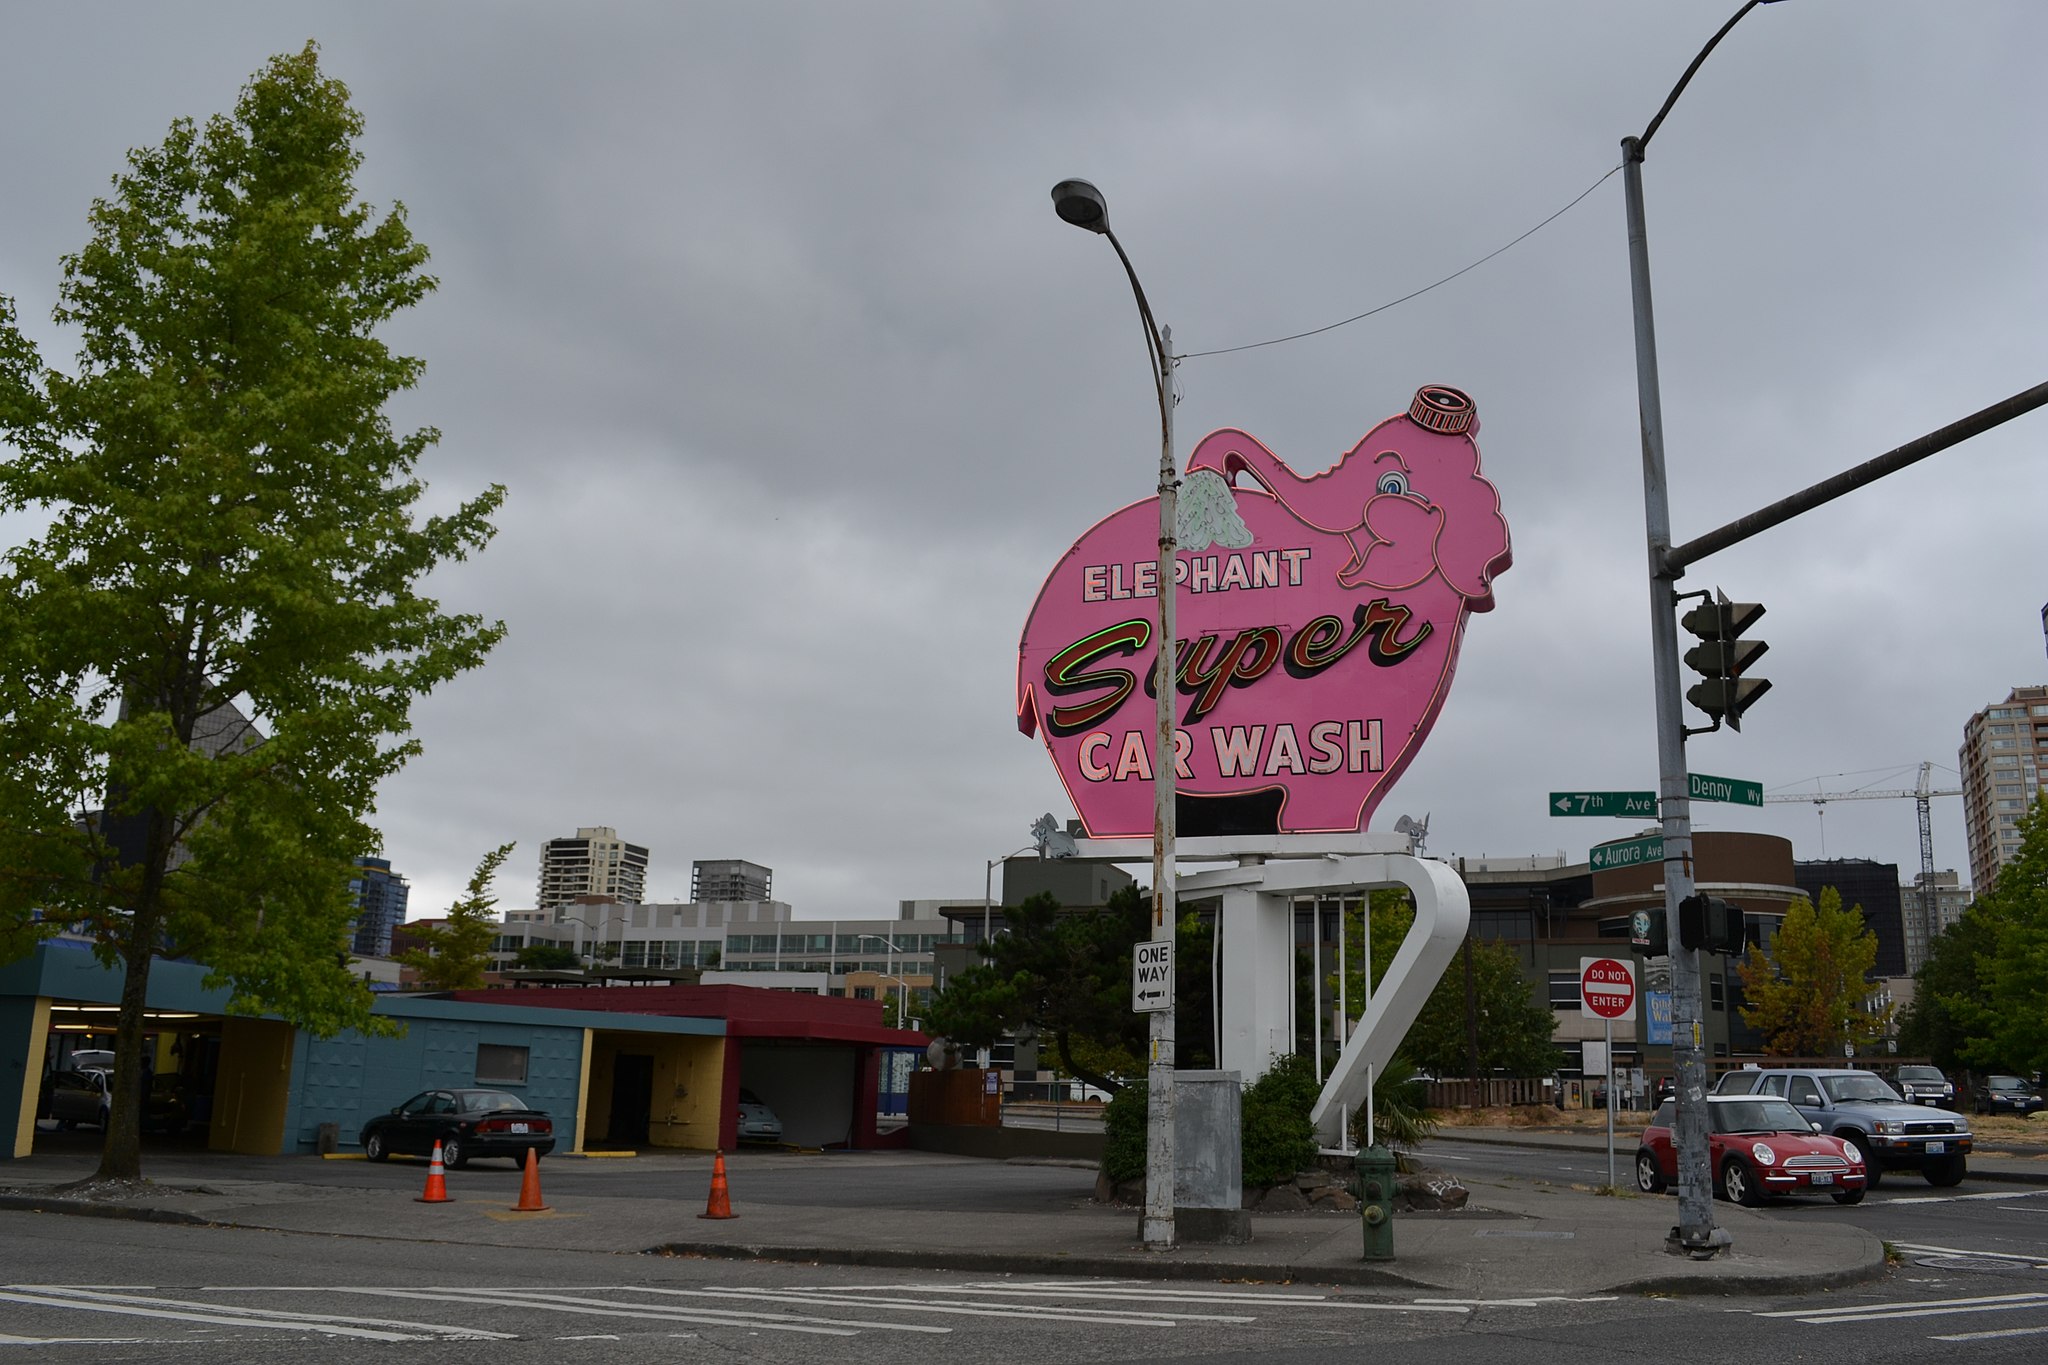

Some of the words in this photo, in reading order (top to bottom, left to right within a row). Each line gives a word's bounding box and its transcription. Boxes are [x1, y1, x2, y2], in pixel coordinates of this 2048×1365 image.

[1044, 598, 1434, 738] Super
[1079, 730, 1196, 783] CAR
[1210, 719, 1384, 778] WASH
[1692, 777, 1732, 800] Denny
[1747, 788, 1761, 805] Wy
[1574, 794, 1604, 813] 7th
[1625, 798, 1651, 811] Ave
[1605, 845, 1641, 866] Aurora
[1646, 845, 1663, 858] Ave
[1138, 946, 1168, 964] ONE
[1138, 965, 1169, 983] WAY
[1591, 969, 1605, 980] DO
[1608, 970, 1626, 981] NOT
[1592, 995, 1625, 1008] ENTER
